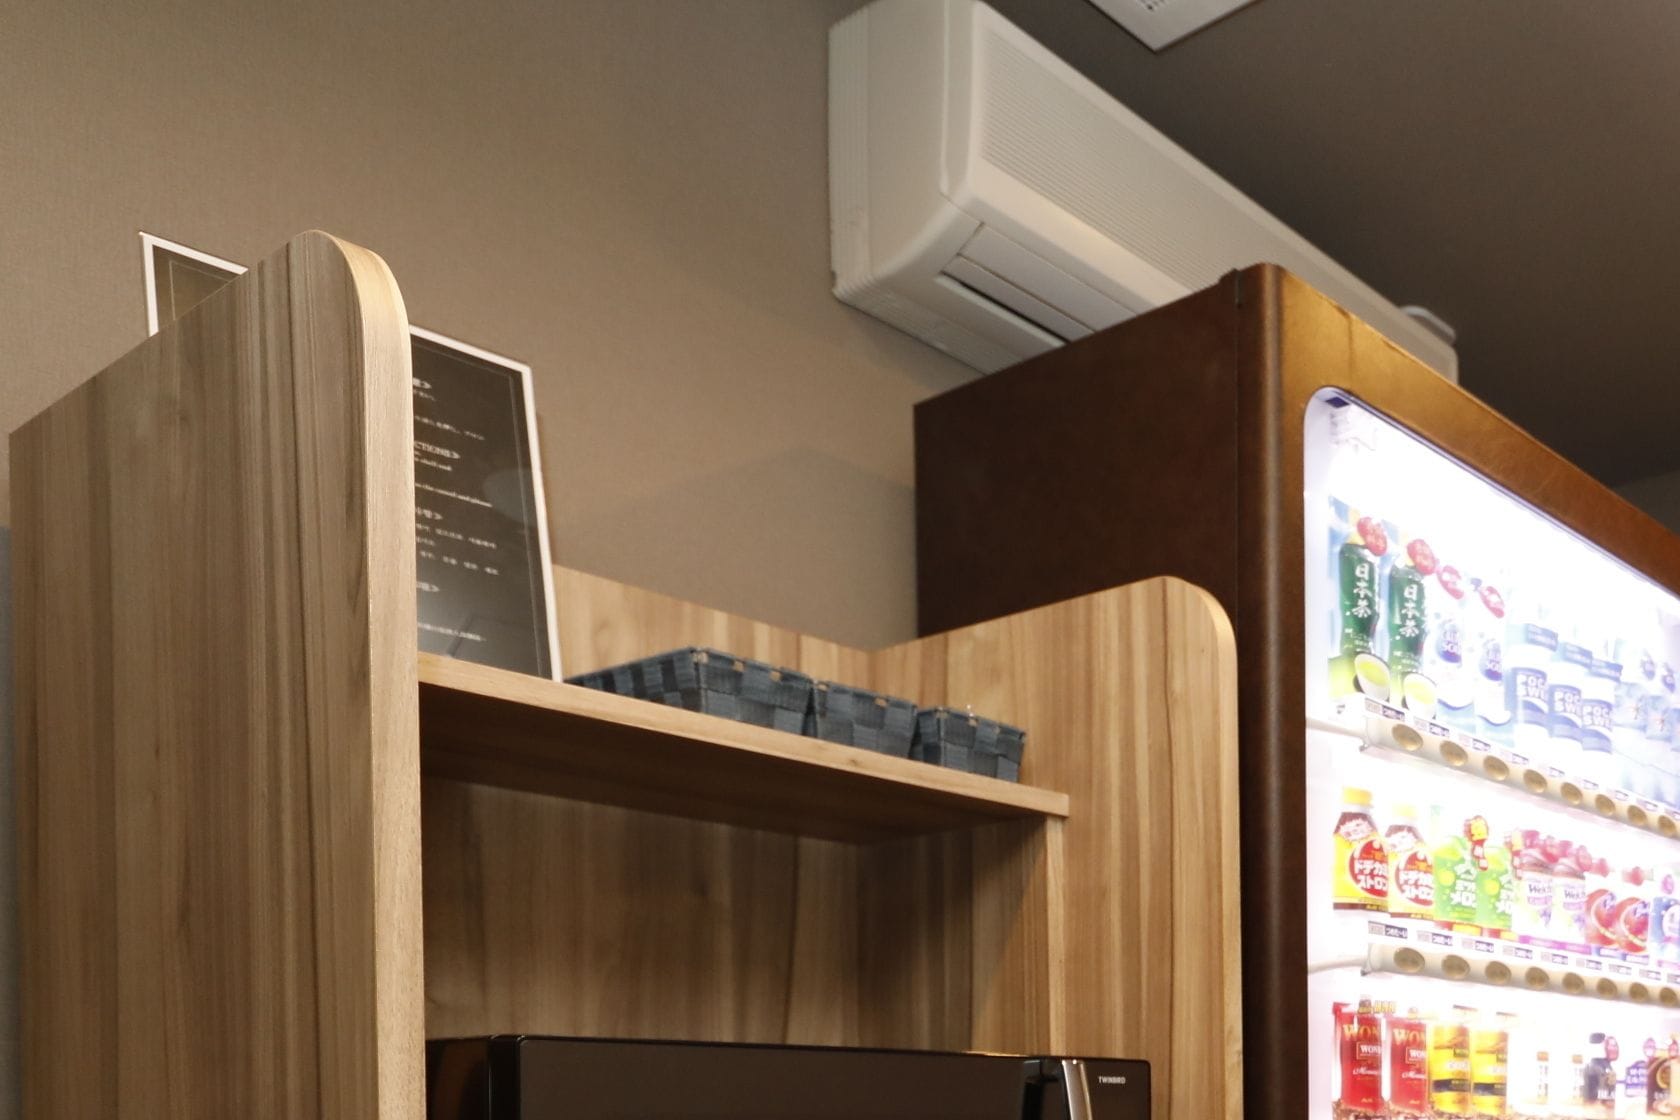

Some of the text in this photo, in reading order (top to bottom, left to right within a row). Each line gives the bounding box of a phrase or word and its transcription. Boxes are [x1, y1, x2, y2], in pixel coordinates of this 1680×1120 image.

[1352, 563, 1373, 618] 日本茶
[1401, 584, 1420, 637] 日本茶
